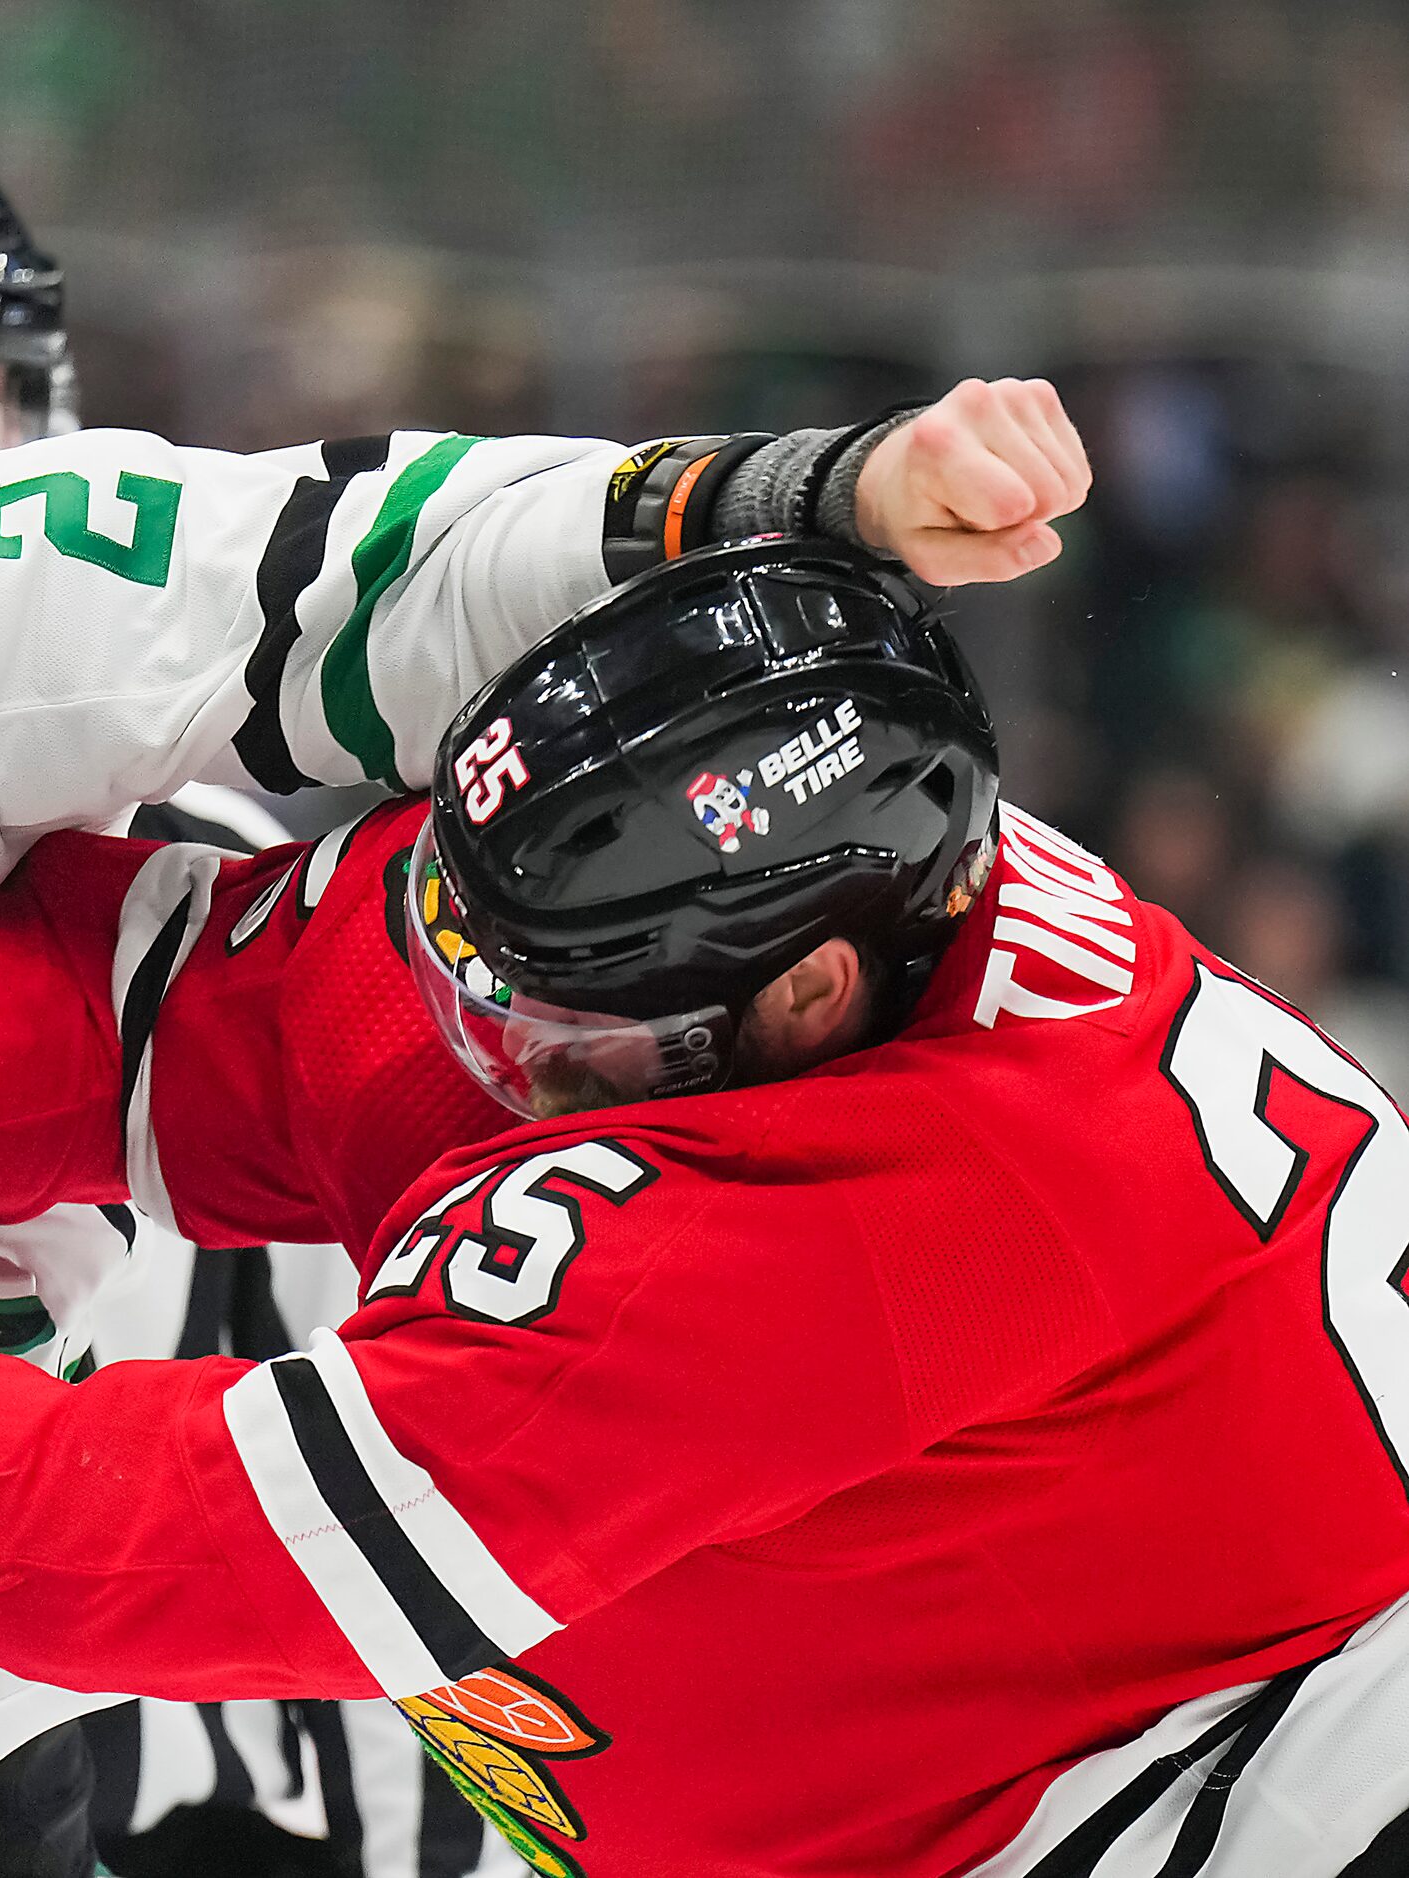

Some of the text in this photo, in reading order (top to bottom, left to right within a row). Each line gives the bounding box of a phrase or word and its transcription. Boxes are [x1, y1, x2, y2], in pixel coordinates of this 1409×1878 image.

[453, 717, 532, 826] 25
[757, 698, 863, 789] BELLE
[783, 735, 866, 806] TIRE
[363, 1136, 662, 1329] 25
